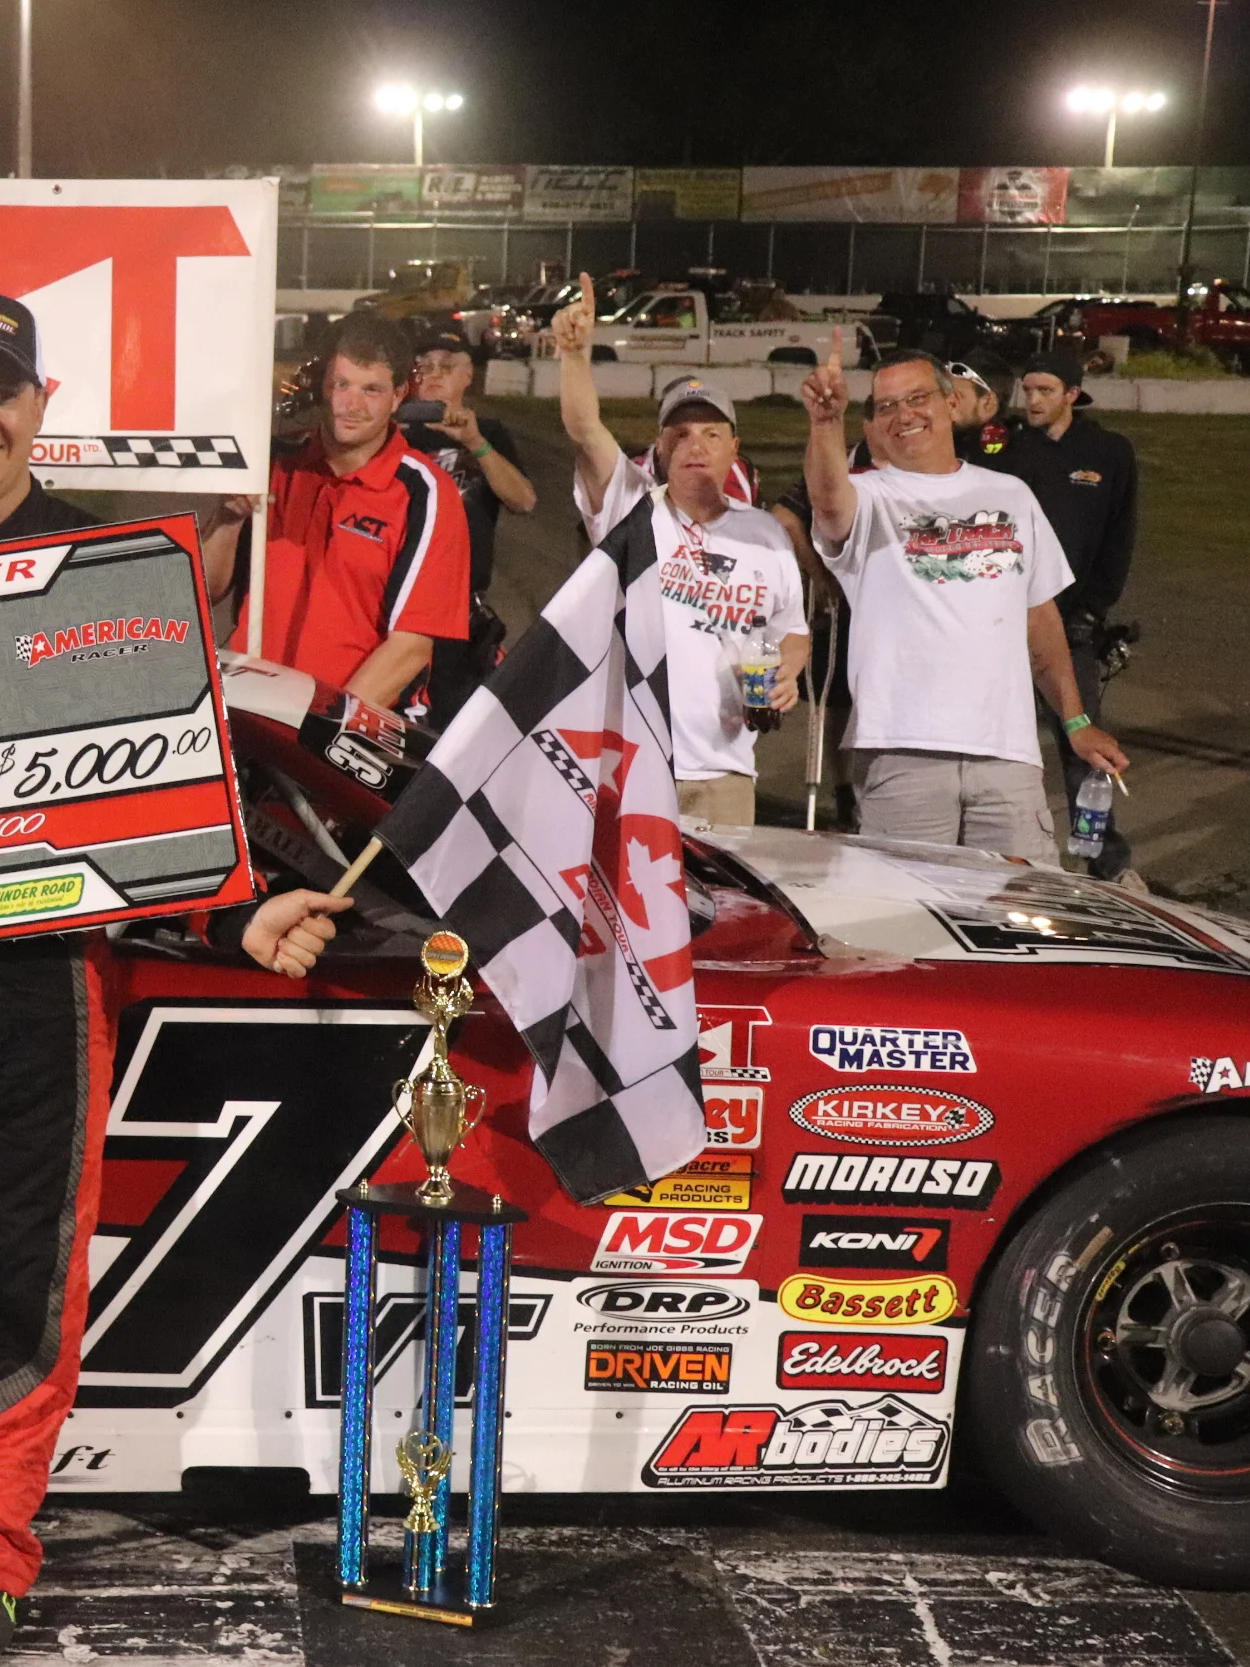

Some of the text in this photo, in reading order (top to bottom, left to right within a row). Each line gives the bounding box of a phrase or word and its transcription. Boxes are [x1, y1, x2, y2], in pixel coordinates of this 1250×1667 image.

[713, 328, 786, 338] TRACK SAFETY
[30, 443, 81, 462] OUR
[27, 617, 190, 668] AMERICAN
[71, 643, 149, 663] RACER
[41, 880, 76, 896] ROAD
[812, 1026, 964, 1056] QUARTER
[838, 1048, 970, 1071] MASTER
[817, 1099, 947, 1122] KIRKEY
[816, 1119, 948, 1132] RACING FABRICATION
[784, 1154, 993, 1197] MOROSO
[673, 1184, 731, 1193] RACING
[659, 1194, 743, 1204] PRODUCTS
[604, 1216, 752, 1255] MSD
[809, 1232, 918, 1250] KONI
[595, 1261, 653, 1270] IGNITION
[600, 1291, 731, 1314] DRP
[796, 1284, 940, 1318] Bassett
[574, 1322, 749, 1335] Performance Products
[591, 1343, 617, 1351] BORN
[783, 1341, 940, 1380] Edelbrock
[1025, 1251, 1084, 1466] RACER
[589, 1351, 730, 1389] DRIVEN
[650, 1381, 724, 1391] RACING OIL
[657, 1476, 723, 1486] ALUMINUM
[724, 1475, 771, 1485] RACING
[773, 1474, 844, 1484] PRODUCTS
